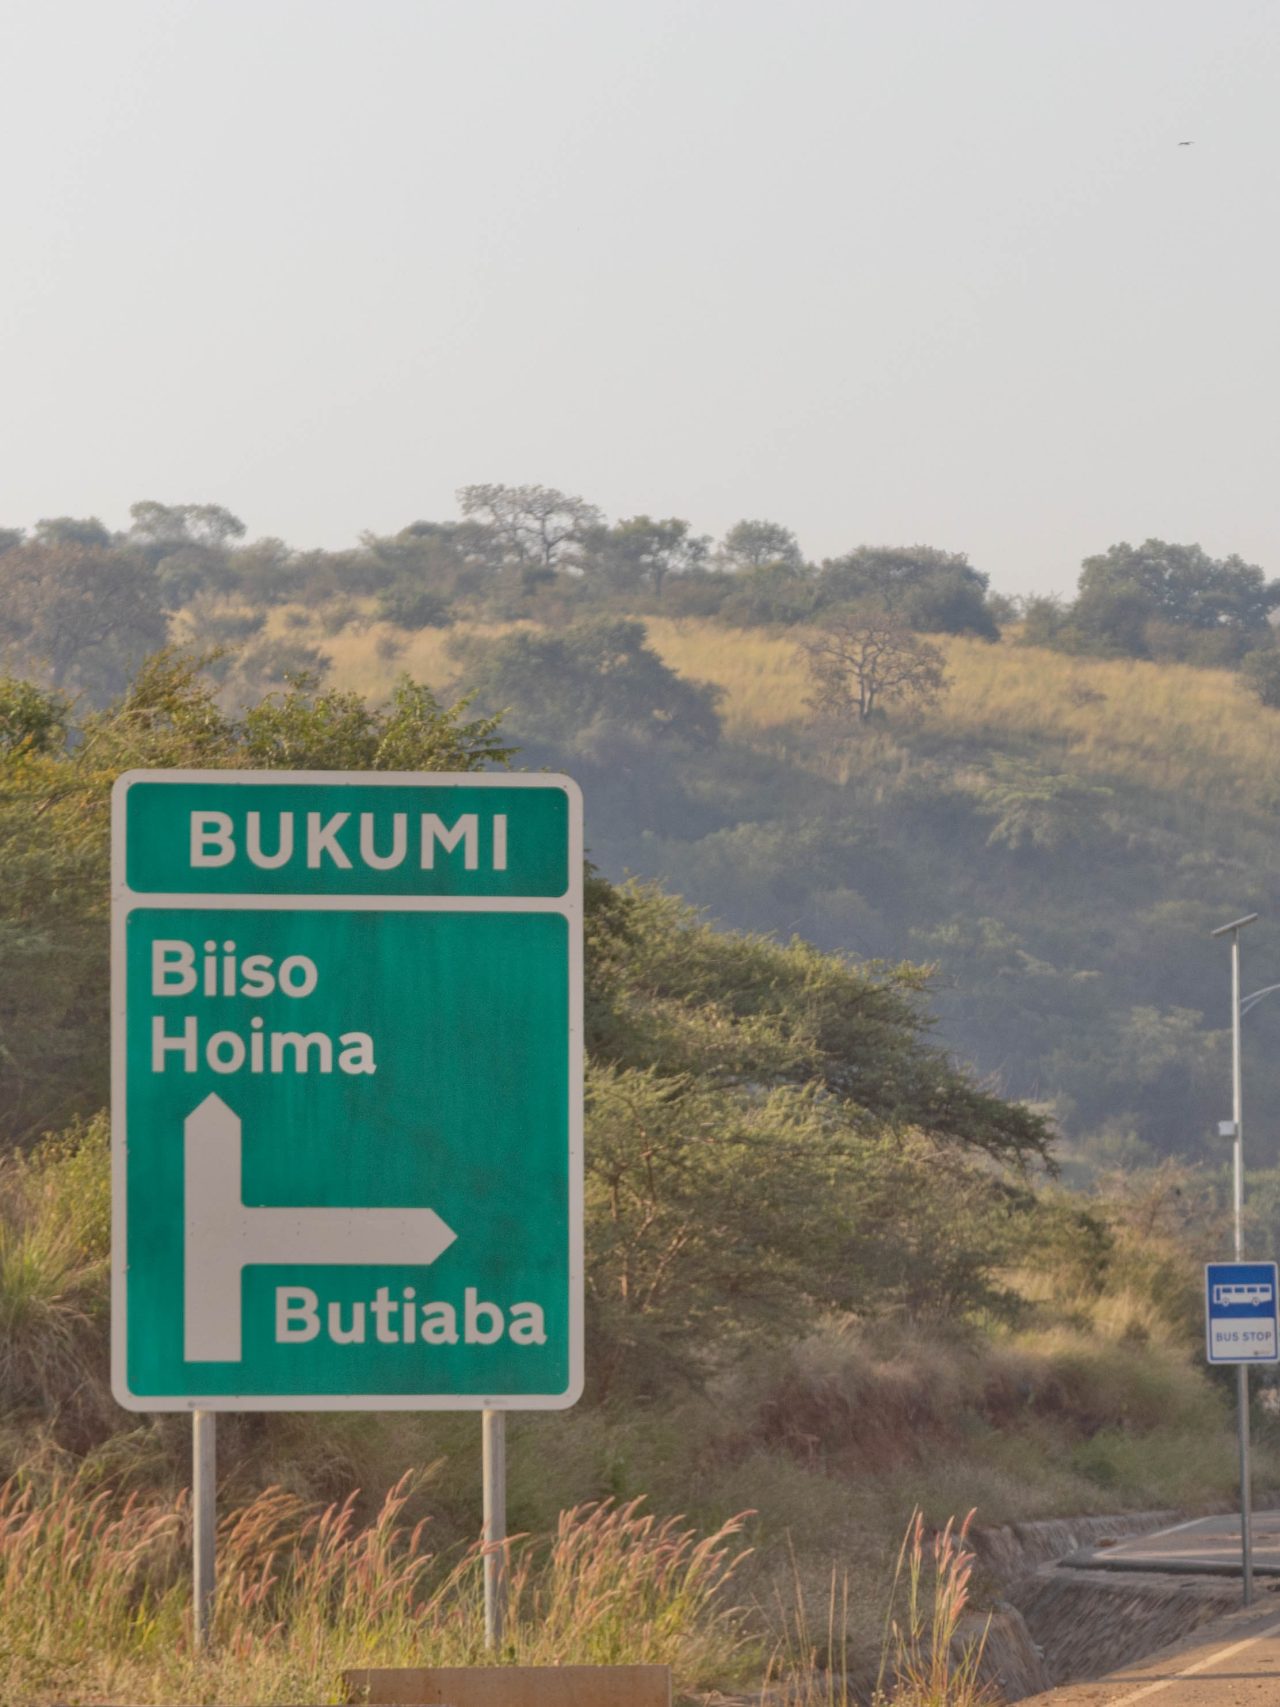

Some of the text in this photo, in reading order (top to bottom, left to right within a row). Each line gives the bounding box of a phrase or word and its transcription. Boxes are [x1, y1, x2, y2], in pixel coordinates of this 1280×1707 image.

[190, 811, 507, 871] BUKUMI
[152, 939, 319, 998] Biiso
[152, 1015, 377, 1075] Hoima
[275, 1286, 548, 1345] Butiaba
[1215, 1331, 1272, 1342] BUS STOP
